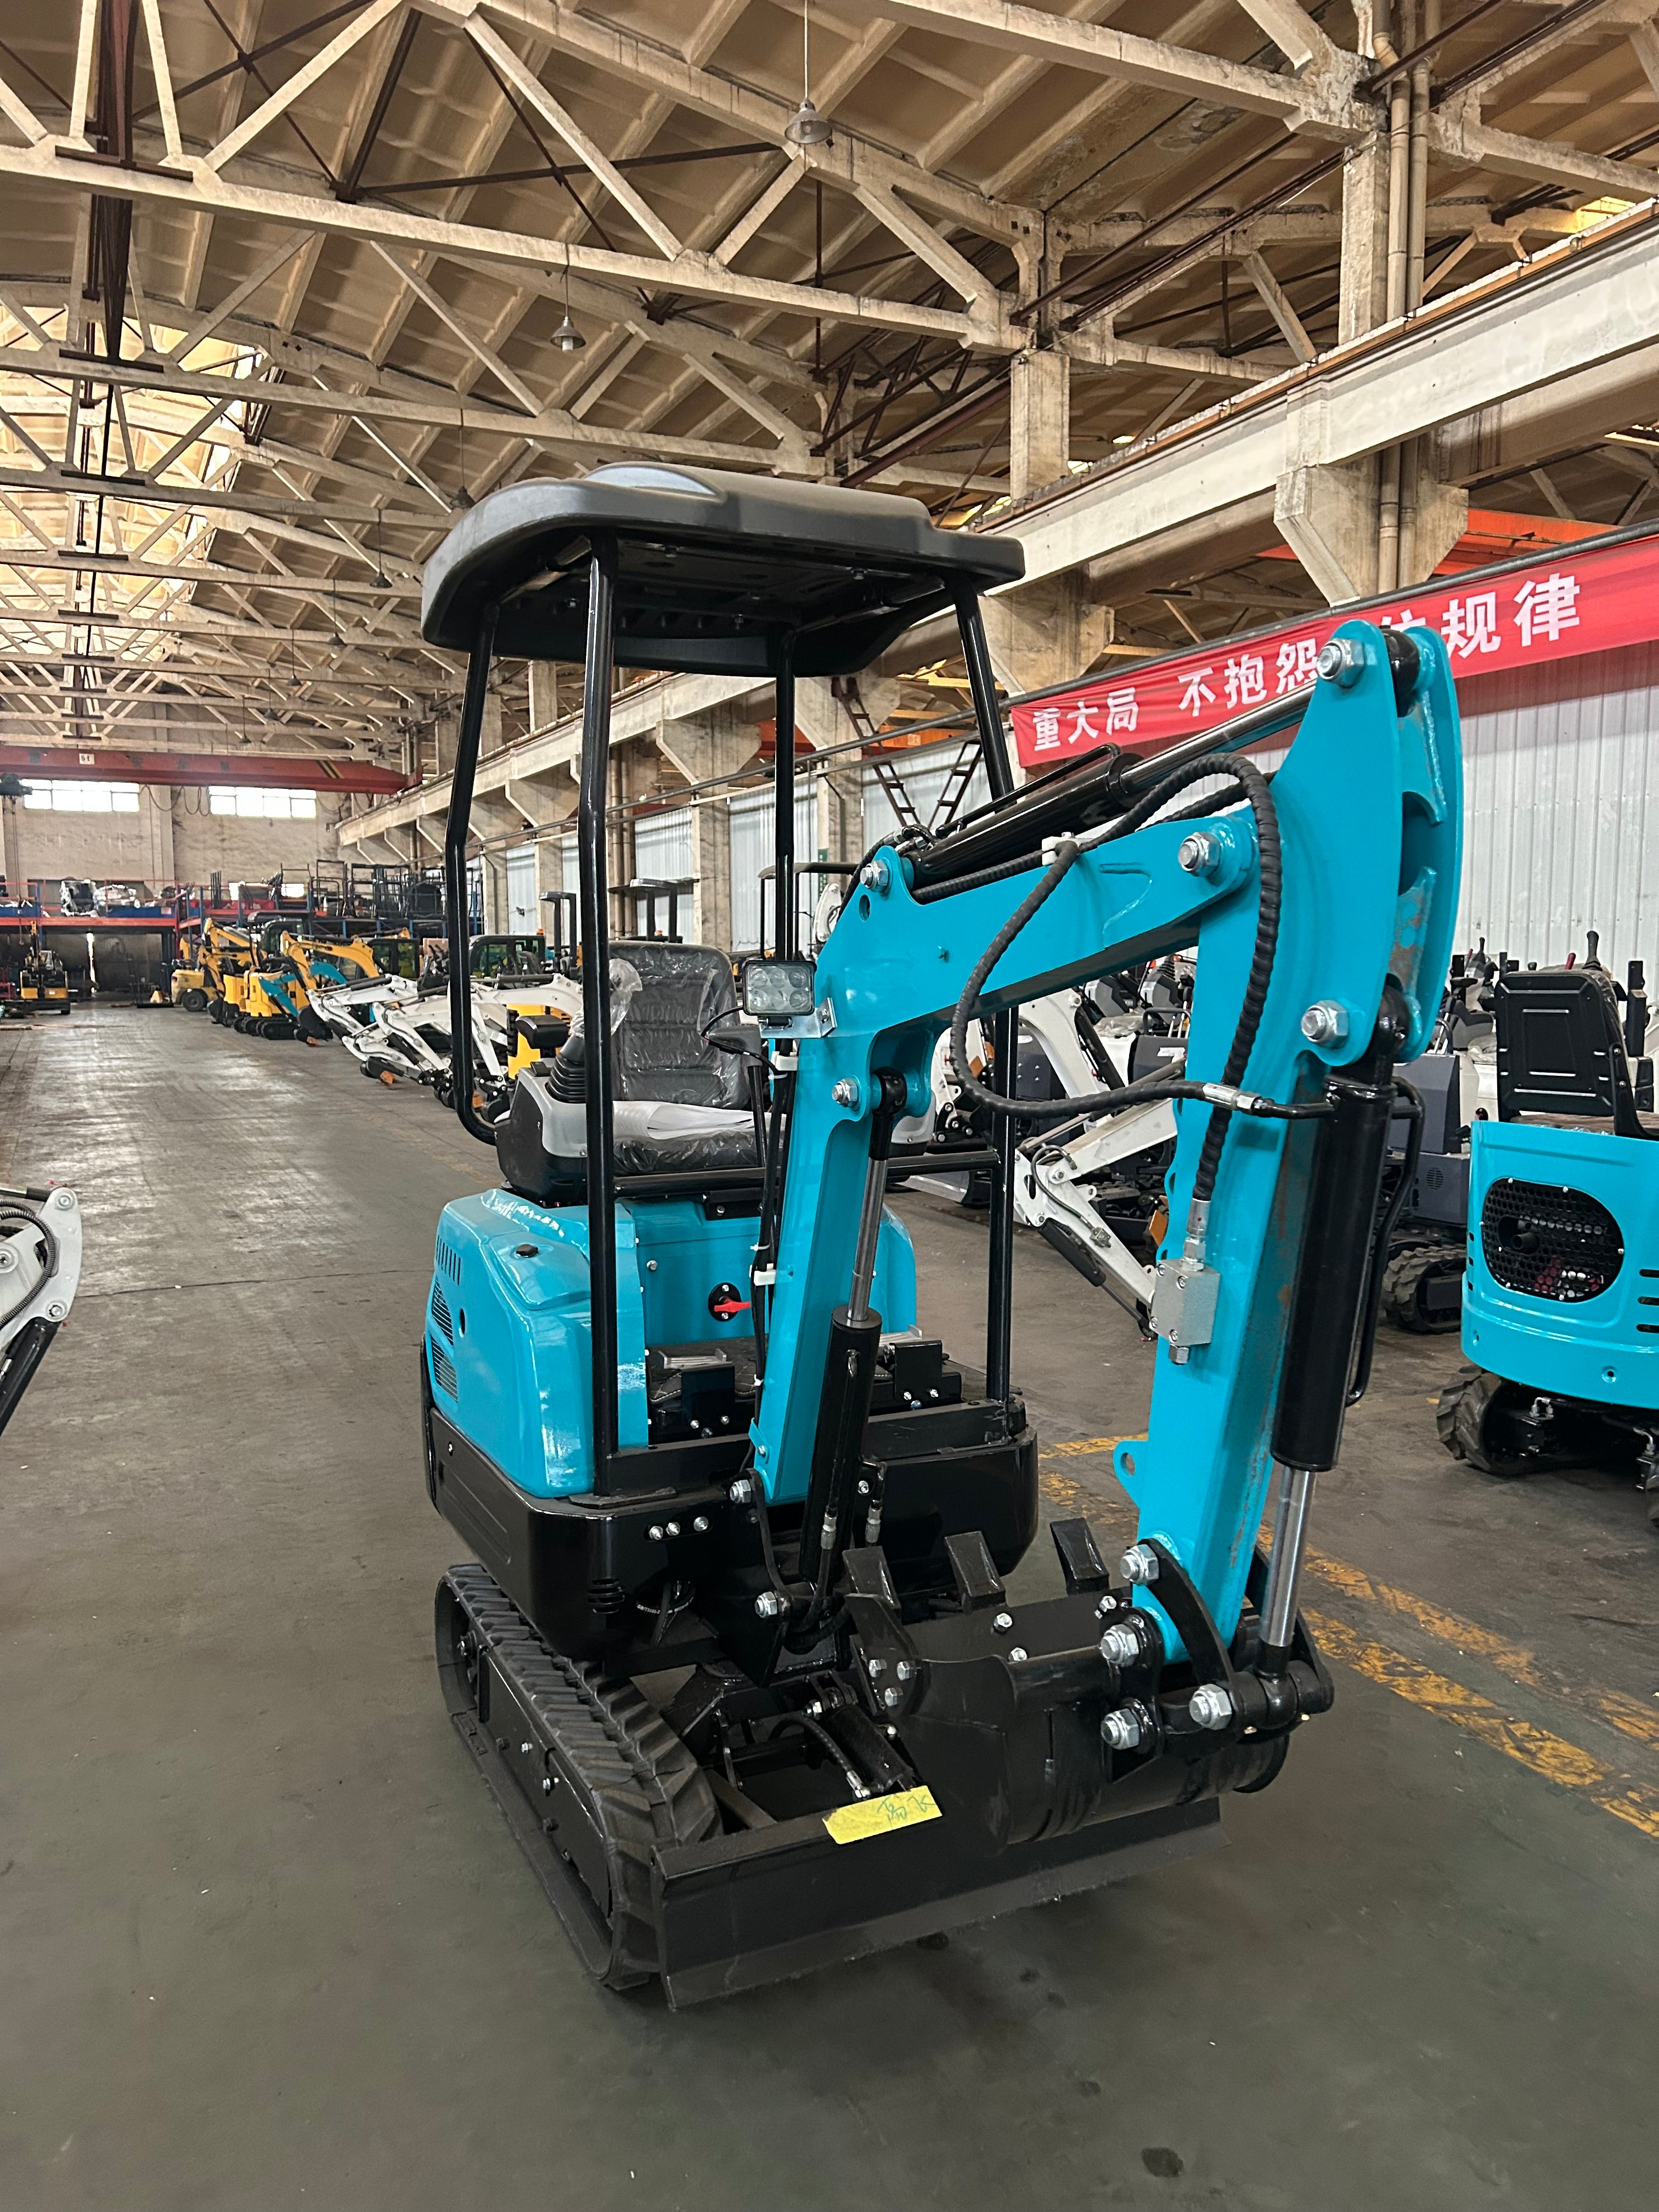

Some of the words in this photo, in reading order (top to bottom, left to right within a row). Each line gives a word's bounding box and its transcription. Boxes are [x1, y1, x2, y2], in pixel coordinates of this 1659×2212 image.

[1032, 687, 1139, 751] 重大局
[1178, 638, 1318, 717] 不抱怨
